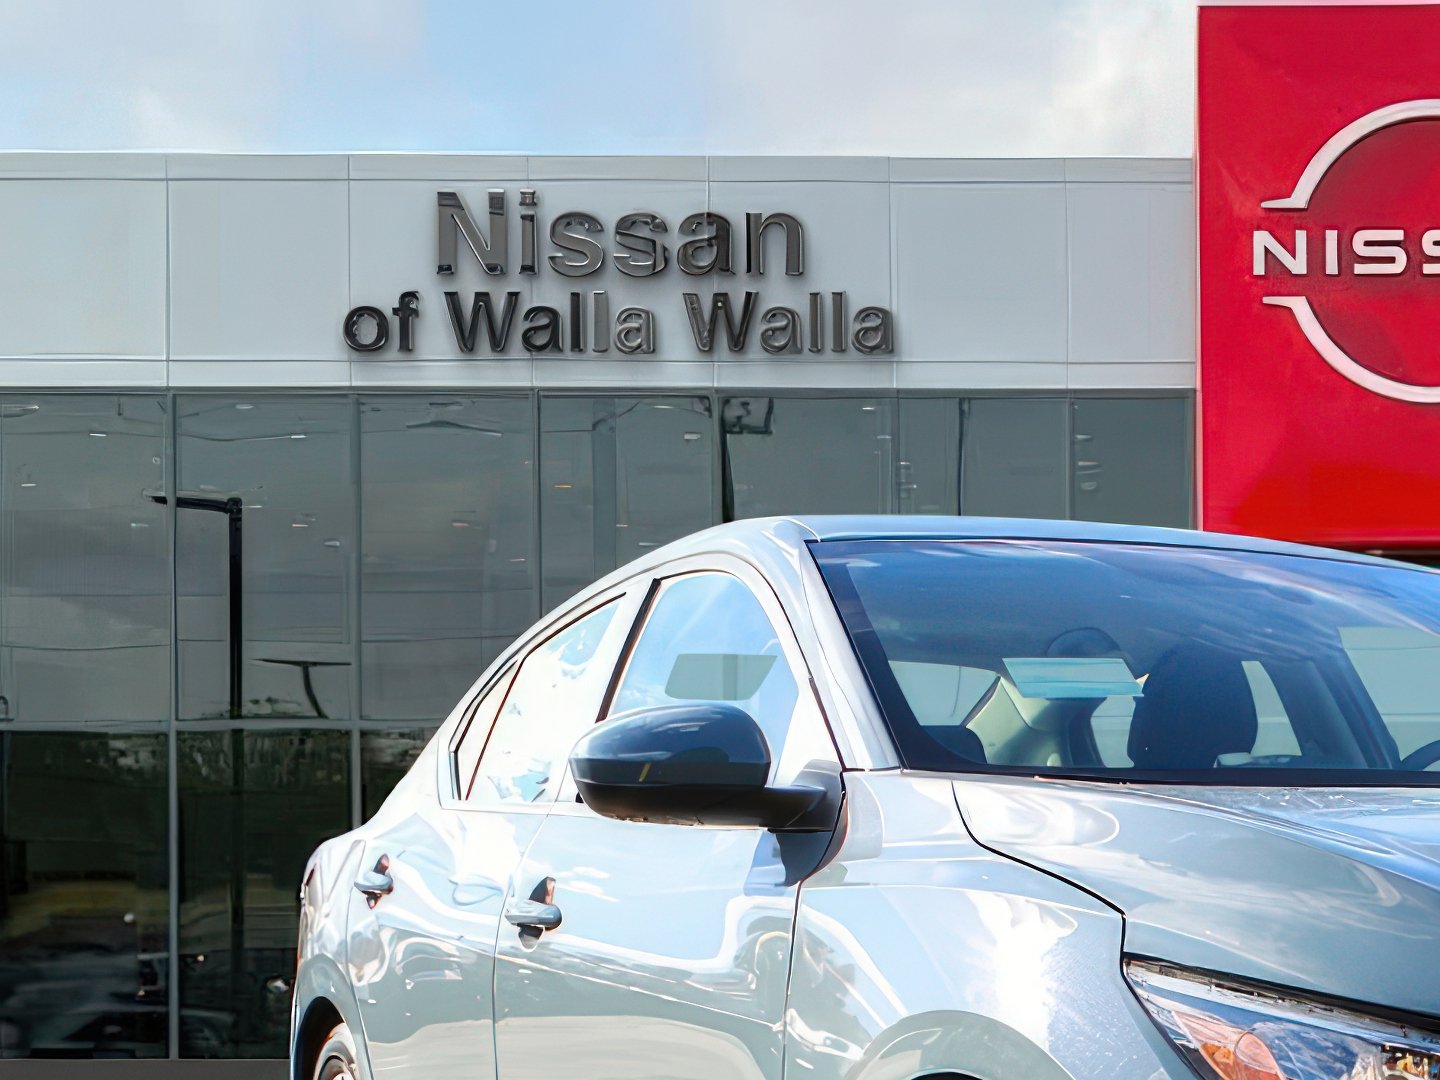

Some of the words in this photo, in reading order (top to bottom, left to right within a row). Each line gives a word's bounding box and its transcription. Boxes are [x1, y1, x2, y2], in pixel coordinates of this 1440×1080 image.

[437, 188, 804, 277] Nissan
[343, 291, 419, 353] of
[444, 291, 655, 353] Walla
[683, 291, 893, 353] Walla
